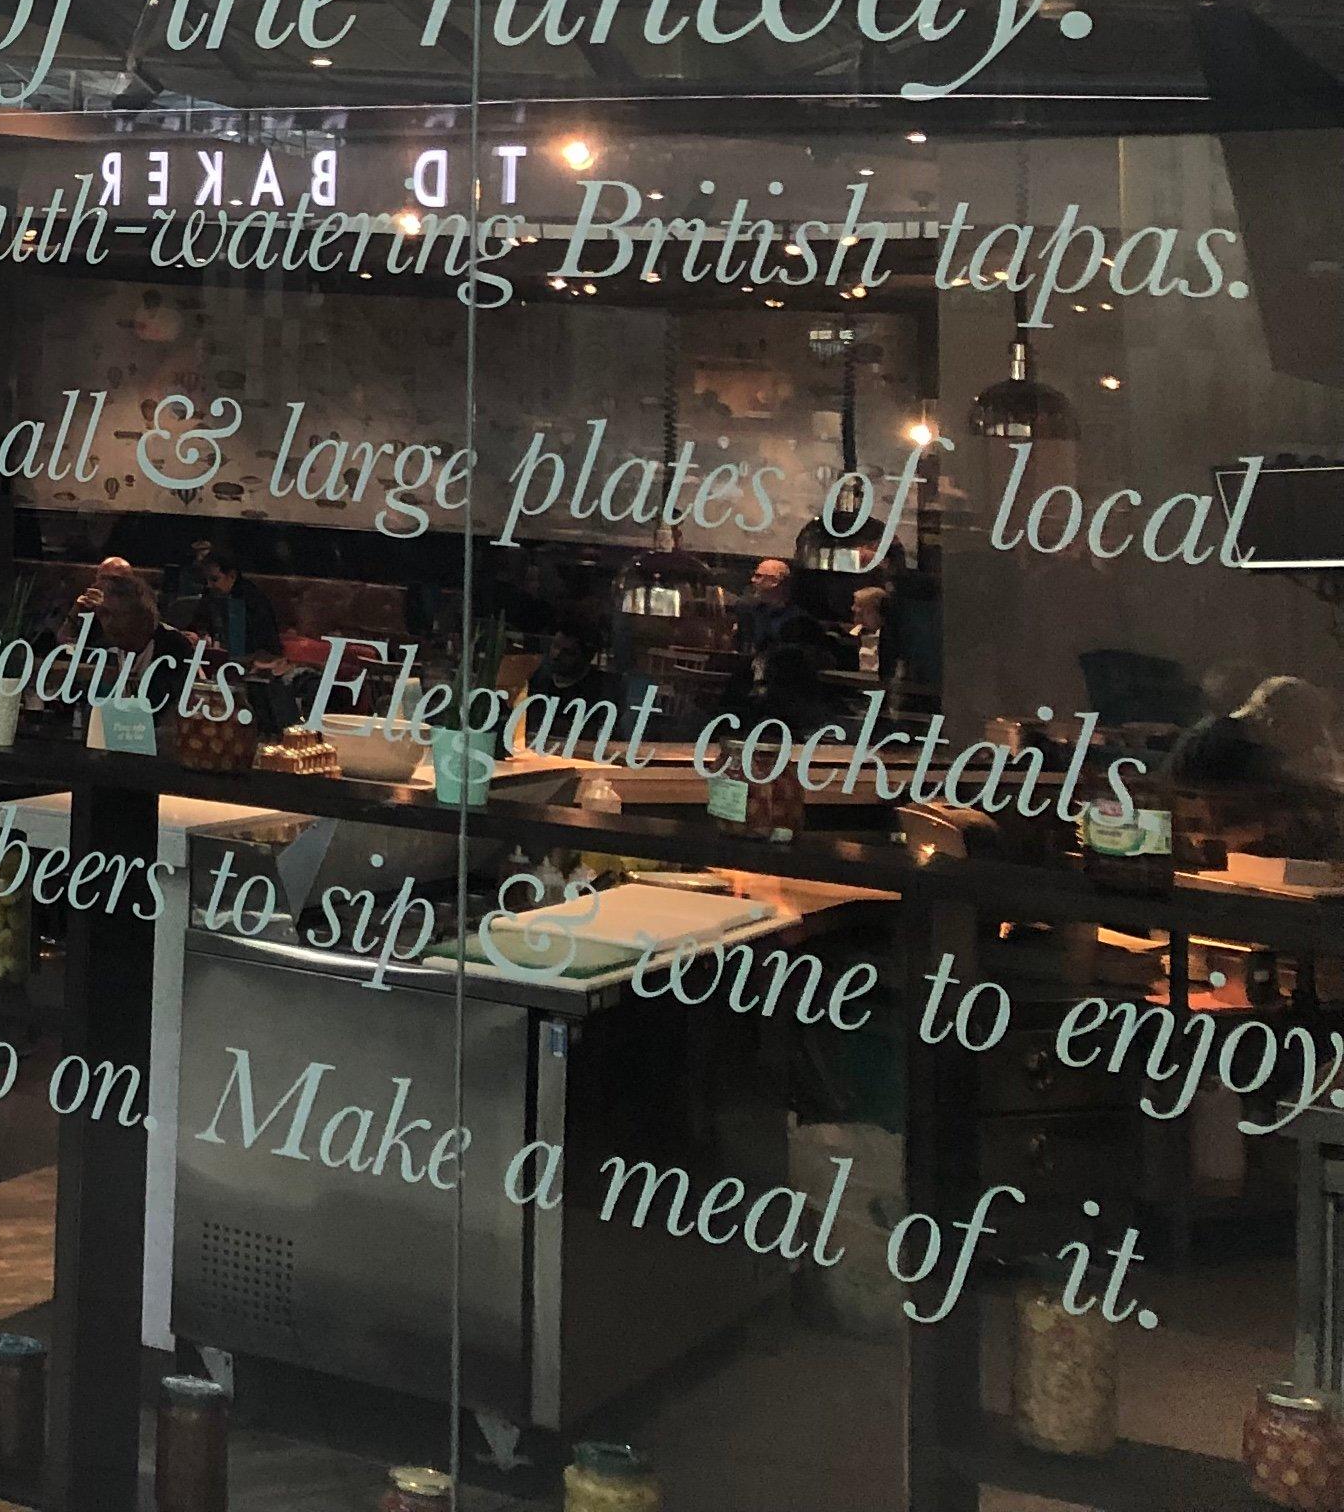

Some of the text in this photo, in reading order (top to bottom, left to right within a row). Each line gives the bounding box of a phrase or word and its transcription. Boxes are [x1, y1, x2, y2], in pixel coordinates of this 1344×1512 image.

[551, 178, 890, 286] British
[935, 204, 1249, 328] tapas.
[138, 394, 242, 490] &
[270, 403, 477, 540] large
[491, 418, 785, 548] plates
[823, 438, 954, 573] of
[991, 443, 1265, 568] local
[306, 635, 660, 786] Elegant
[206, 850, 277, 936] to
[307, 854, 434, 991] sip
[479, 872, 600, 981] &
[630, 908, 878, 1032] wine
[919, 952, 1012, 1052] to
[1055, 972, 1344, 1134] enjoy.
[50, 1055, 159, 1132] on.
[195, 1046, 472, 1190] Make
[503, 1139, 564, 1210] a
[600, 1156, 852, 1268] meal
[887, 1184, 1026, 1324] of
[1055, 1201, 1159, 1329] it.
